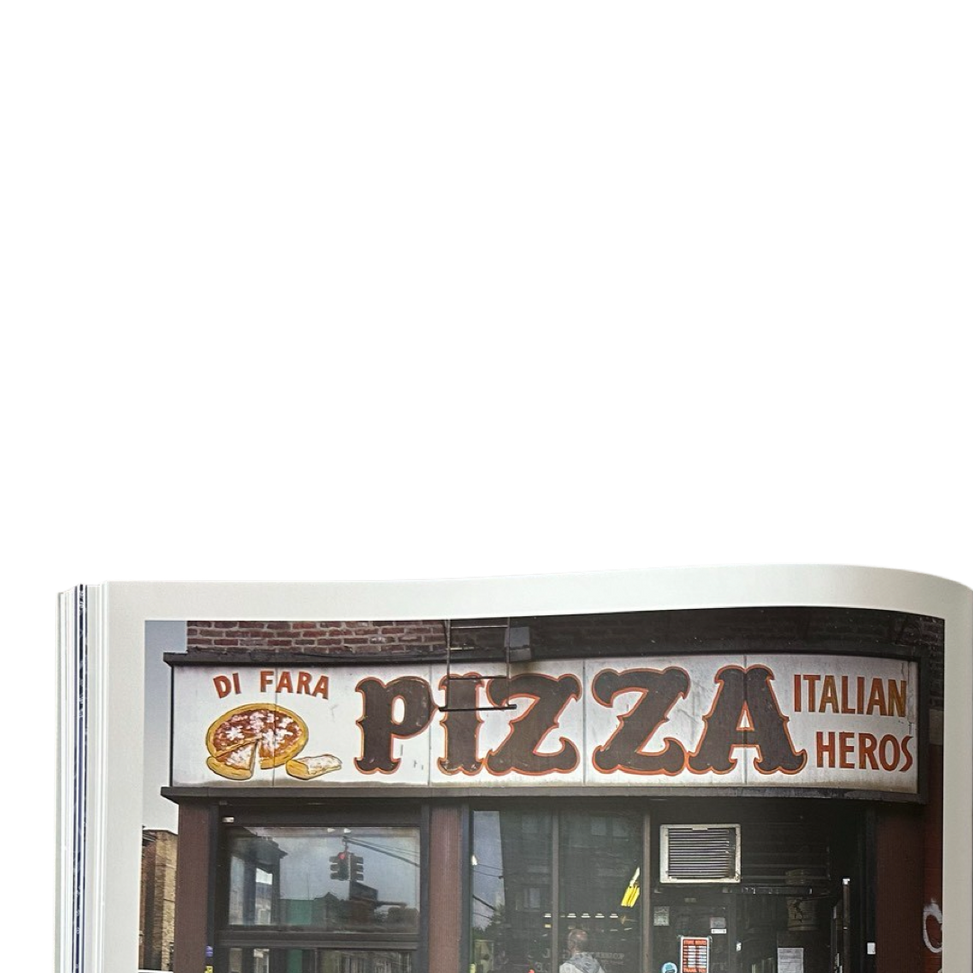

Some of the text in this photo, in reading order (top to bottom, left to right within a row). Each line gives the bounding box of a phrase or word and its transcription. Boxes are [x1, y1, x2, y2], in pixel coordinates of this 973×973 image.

[213, 671, 330, 700] DI FARA
[794, 674, 907, 718] ITALIAN
[355, 665, 808, 777] PIZZA
[816, 731, 913, 772] HEROS
